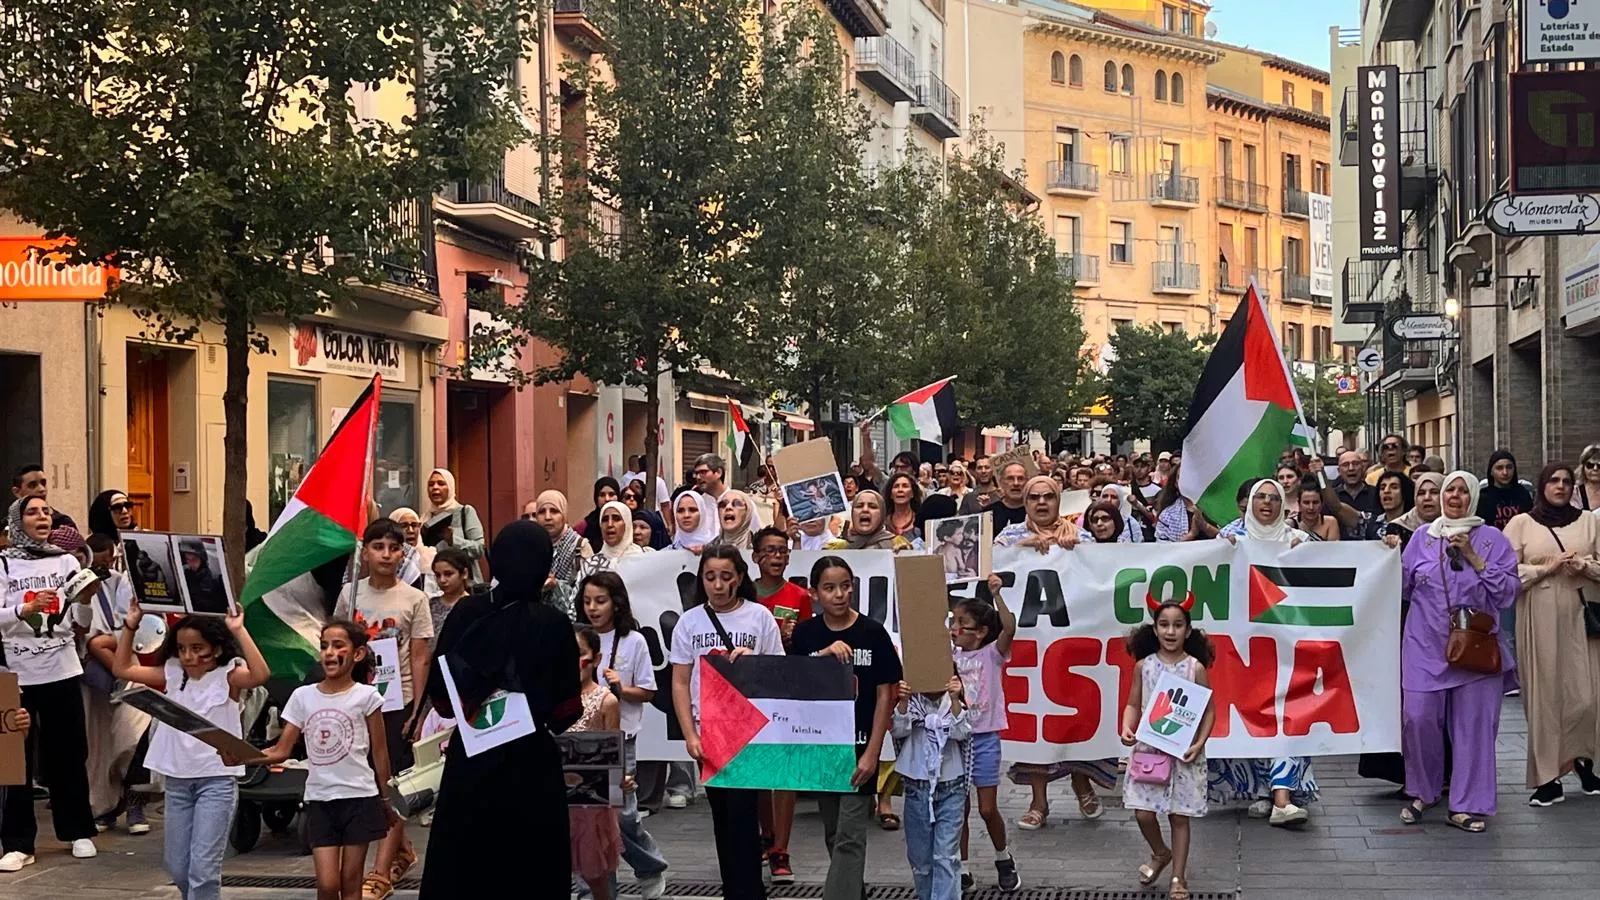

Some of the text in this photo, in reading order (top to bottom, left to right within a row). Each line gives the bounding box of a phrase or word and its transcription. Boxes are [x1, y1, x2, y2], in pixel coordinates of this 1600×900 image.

[1540, 21, 1589, 31] Loterías y
[1541, 33, 1586, 42] Apuestas
[1540, 43, 1574, 52] Estado
[1368, 70, 1387, 241] Montovelaz
[1503, 200, 1590, 219] Montovelaz
[1361, 245, 1398, 254] muebles
[0, 247, 102, 287] odimela
[323, 333, 400, 369] COLOR NAILS
[1113, 564, 1231, 624] CON
[692, 632, 734, 650] PALESTA
[772, 711, 789, 722] Free
[1174, 706, 1198, 721] STOP
[792, 725, 822, 735] Palestina
